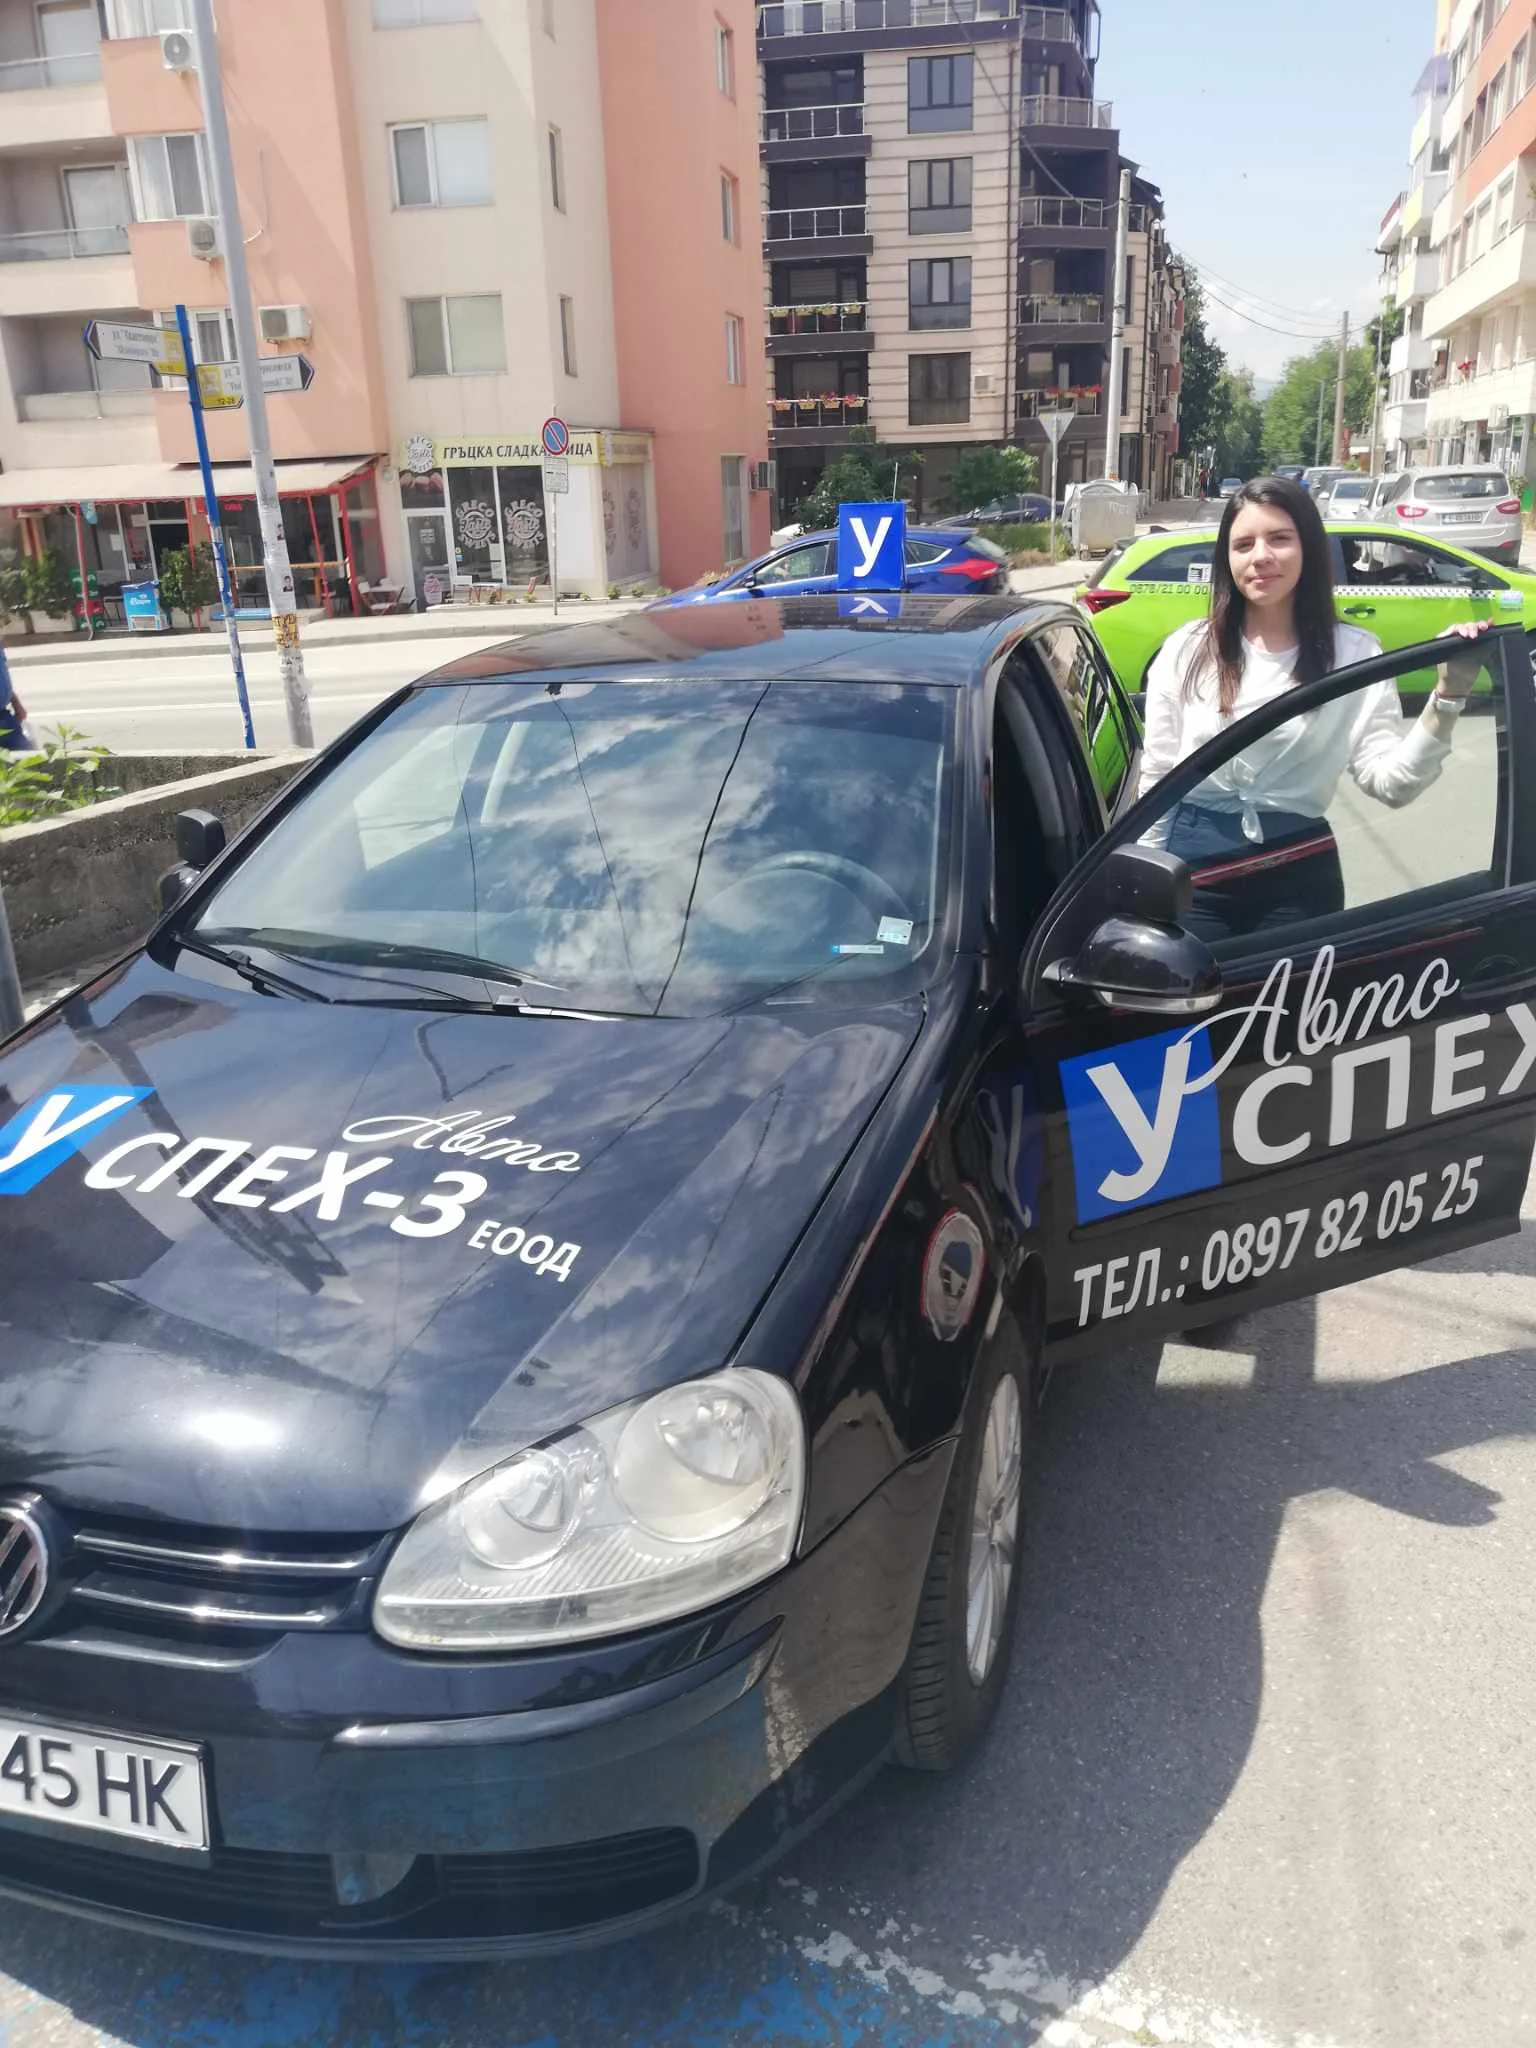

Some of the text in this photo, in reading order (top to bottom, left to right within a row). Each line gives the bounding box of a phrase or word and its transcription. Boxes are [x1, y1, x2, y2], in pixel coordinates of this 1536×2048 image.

[443, 445, 493, 460] ГРЪЦКА
[496, 442, 593, 459] СЛАДКАИЦА
[455, 499, 495, 518] GRECO
[1177, 944, 1460, 1094] Авто
[341, 1109, 582, 1173] Авто
[466, 1219, 582, 1284] ЕООД
[1074, 1154, 1485, 1328] ТЕЛ.: 0897 82 05 25
